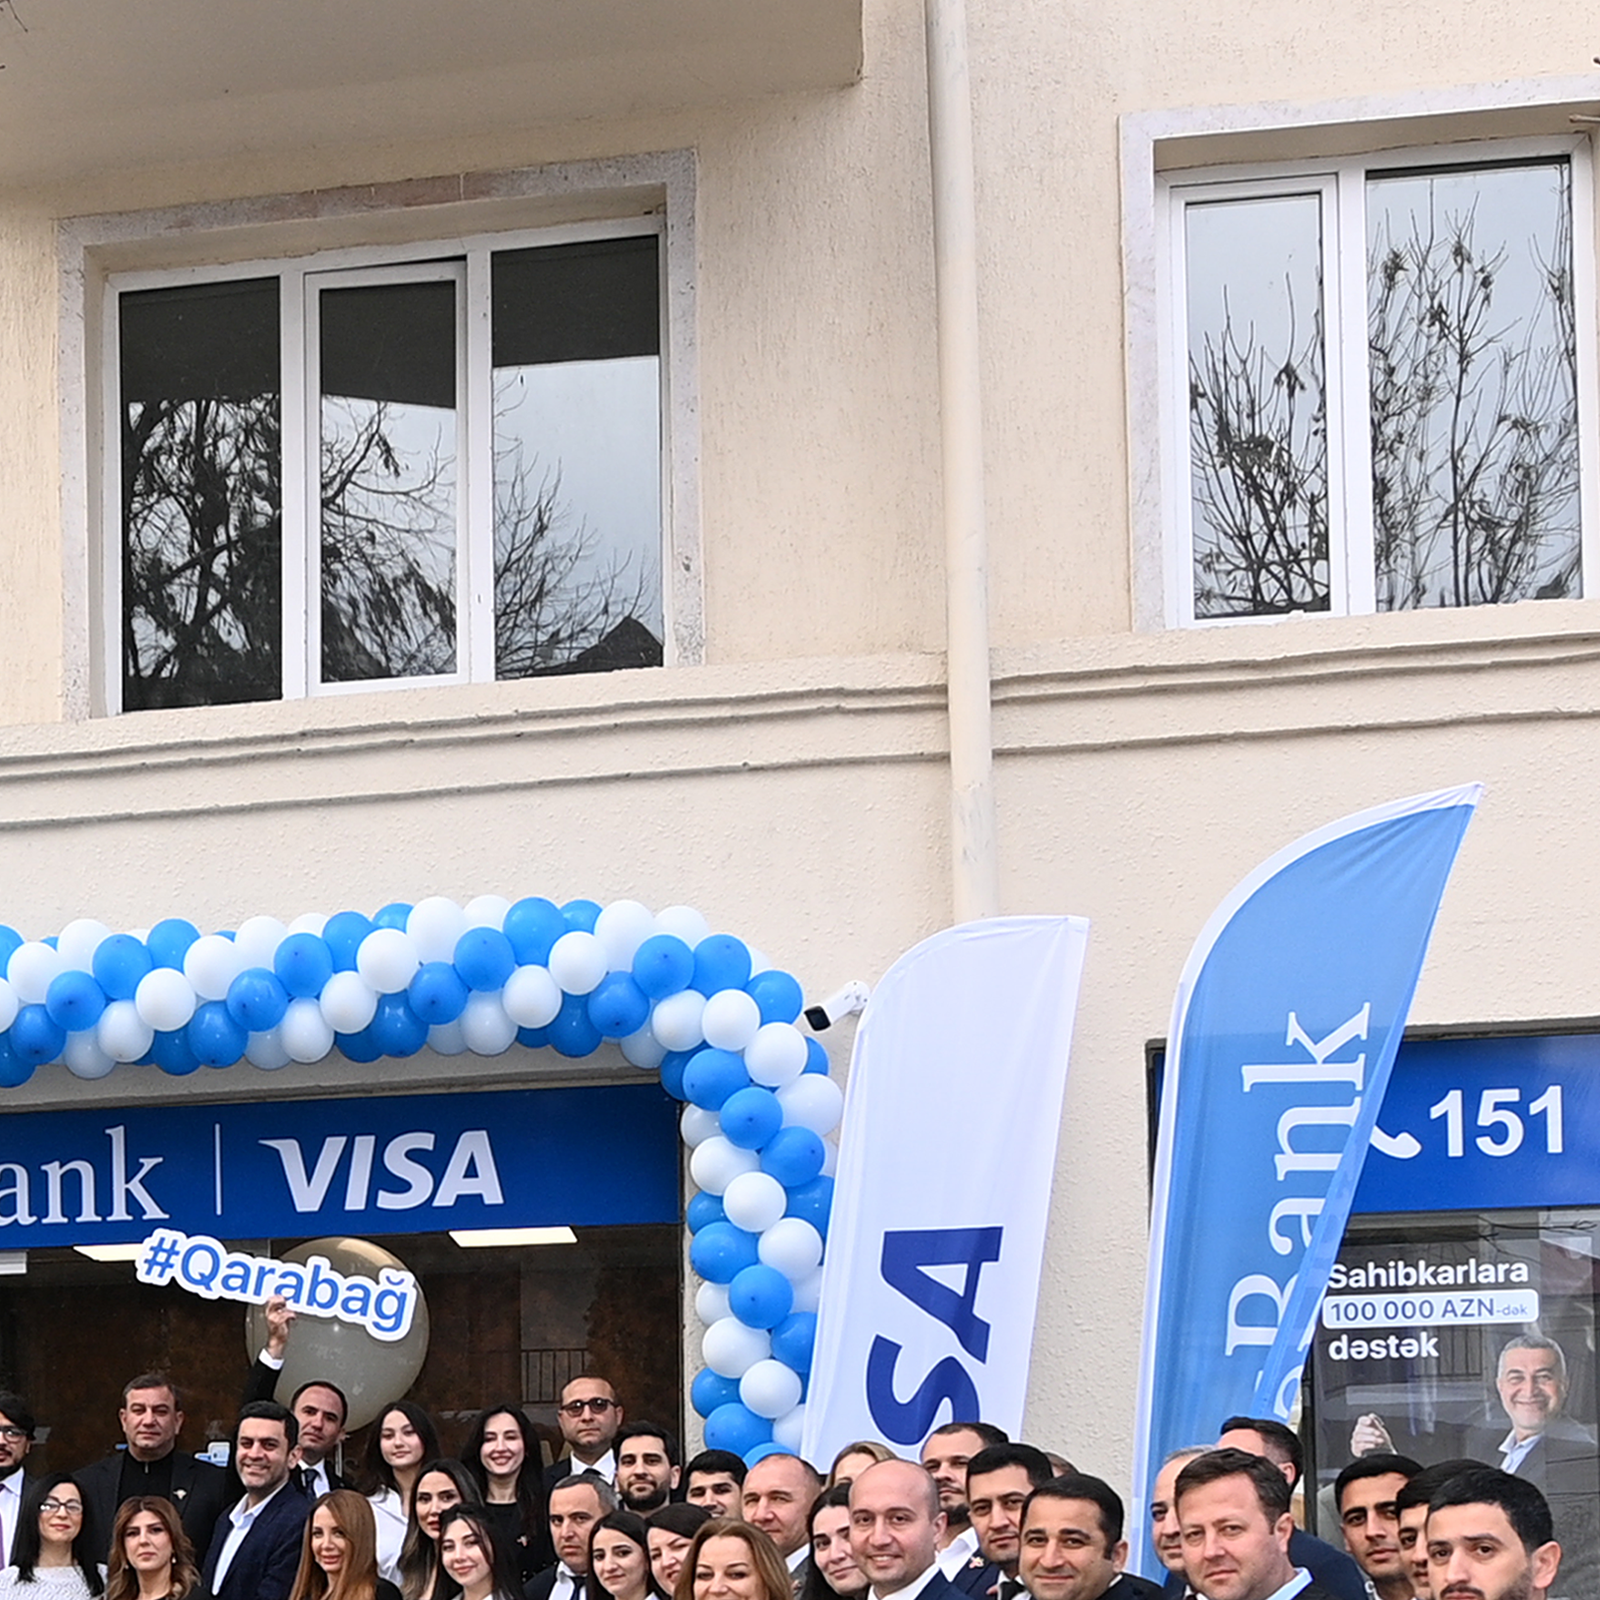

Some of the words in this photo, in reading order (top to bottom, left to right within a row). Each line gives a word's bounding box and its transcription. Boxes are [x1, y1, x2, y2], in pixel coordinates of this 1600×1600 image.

[1429, 1085, 1563, 1158] 151
[258, 1130, 504, 1213] VISA
[143, 1237, 408, 1332] #Qarabağ
[1327, 1258, 1529, 1289] Sahibkarlara
[1331, 1301, 1377, 1322] 100
[1384, 1299, 1435, 1320] 000
[1328, 1331, 1439, 1361] dəstək
